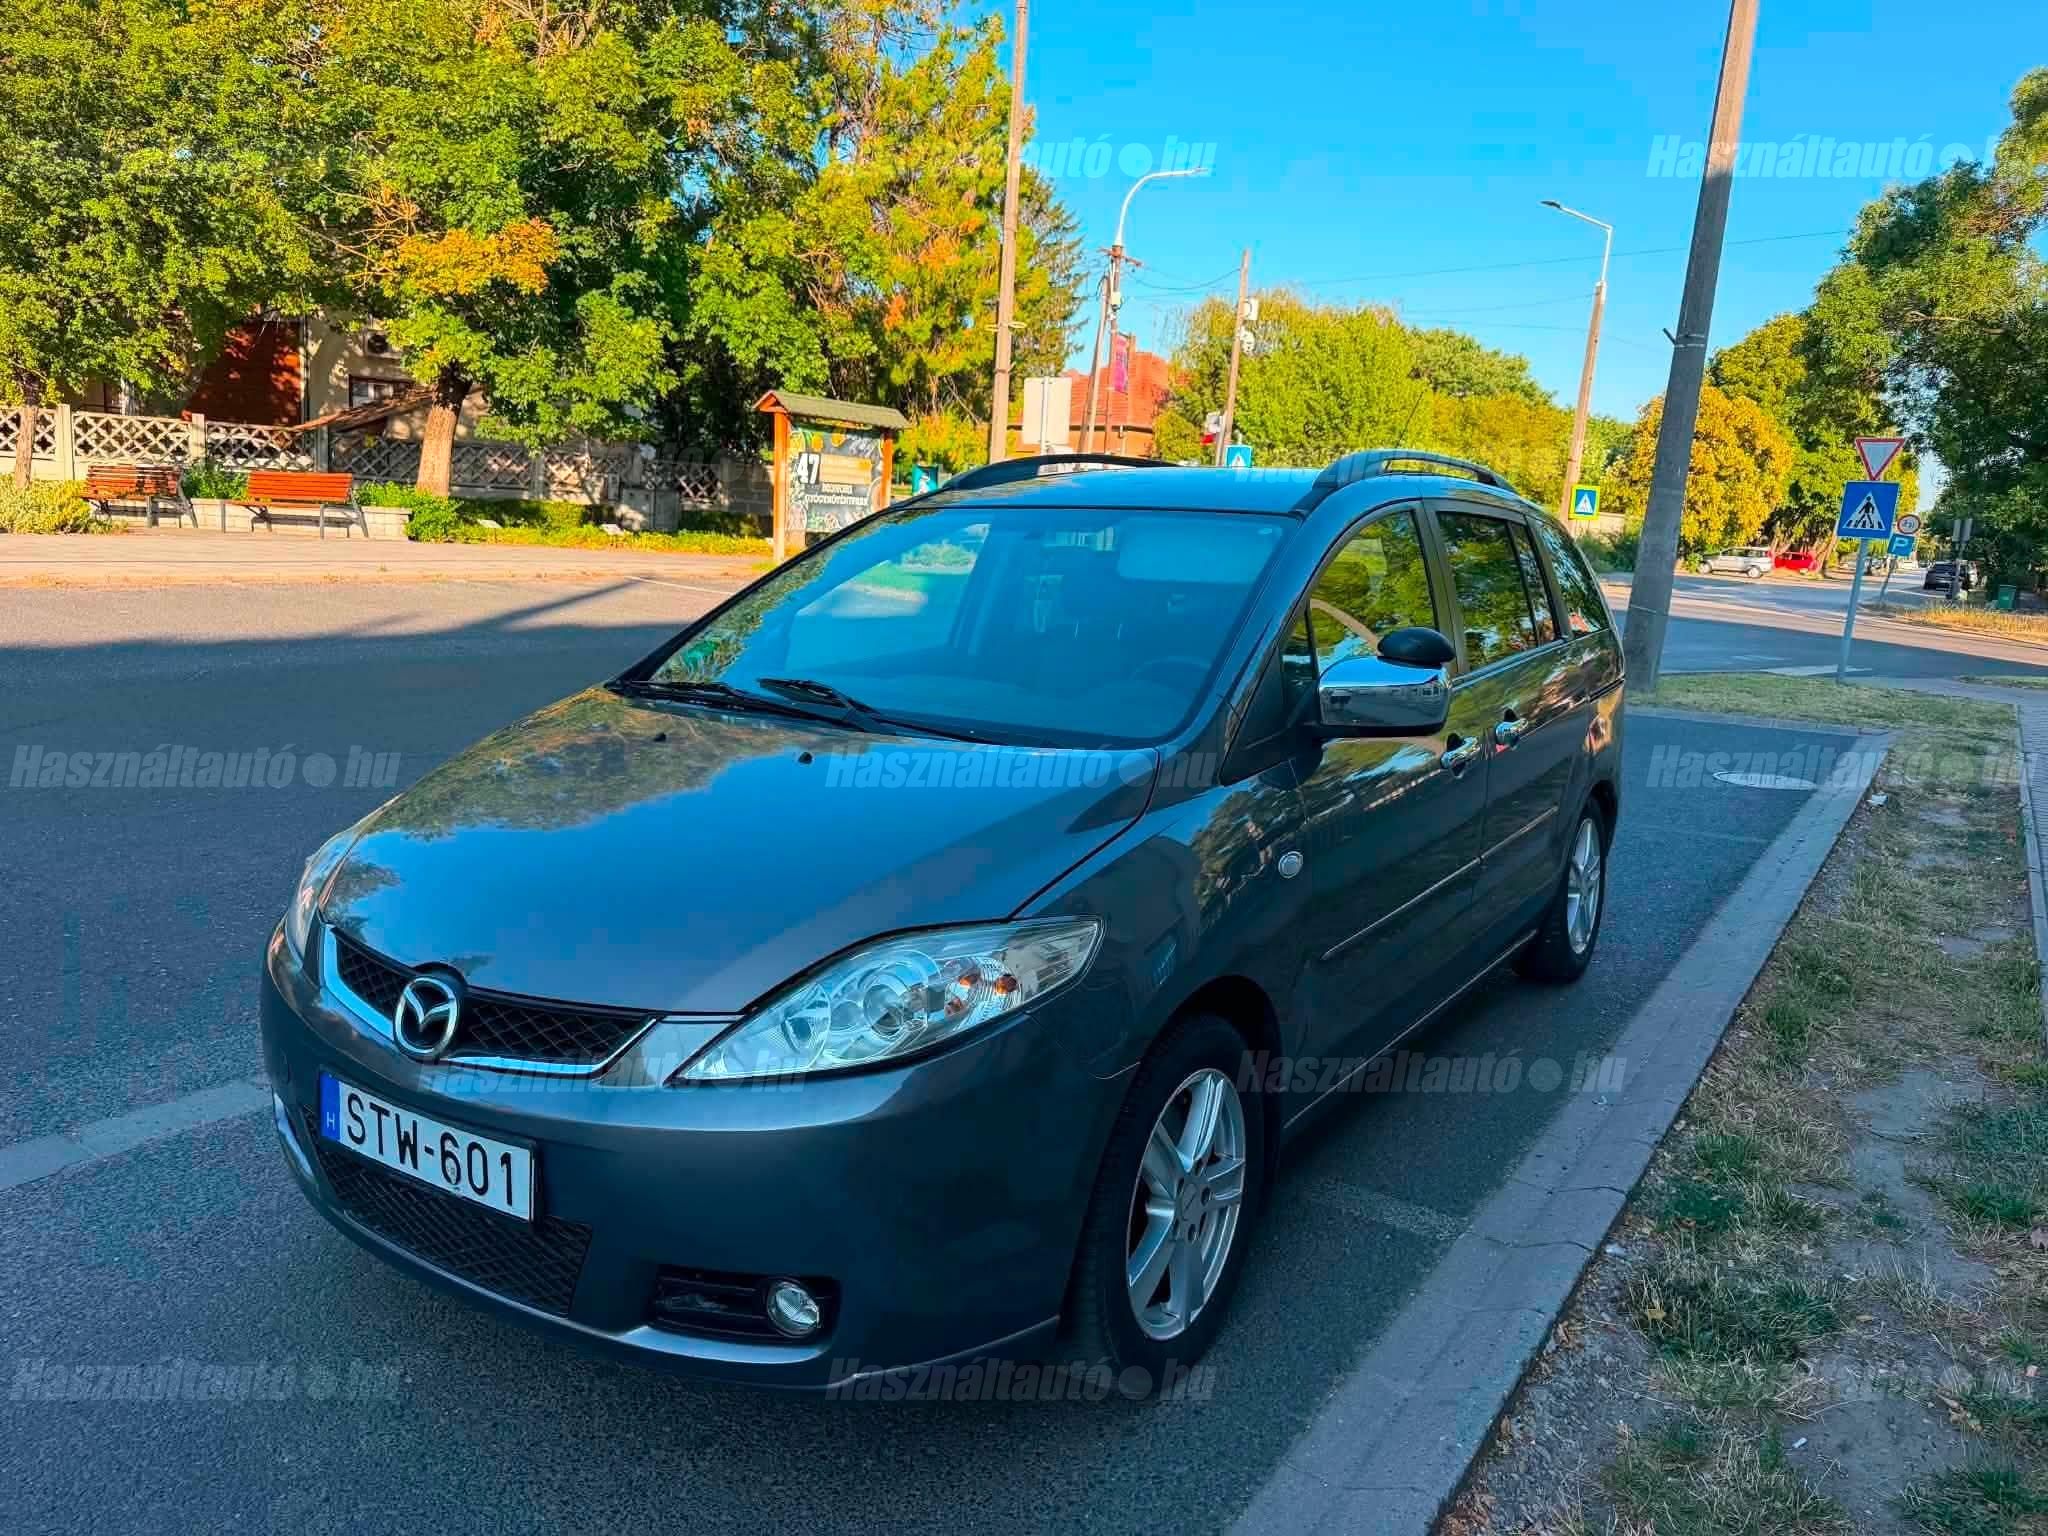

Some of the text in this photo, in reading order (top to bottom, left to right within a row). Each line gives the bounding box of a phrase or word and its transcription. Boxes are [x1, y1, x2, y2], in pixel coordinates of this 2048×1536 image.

[1892, 536, 1909, 552] P
[326, 1111, 336, 1131] H
[347, 1093, 513, 1206] STW-601
